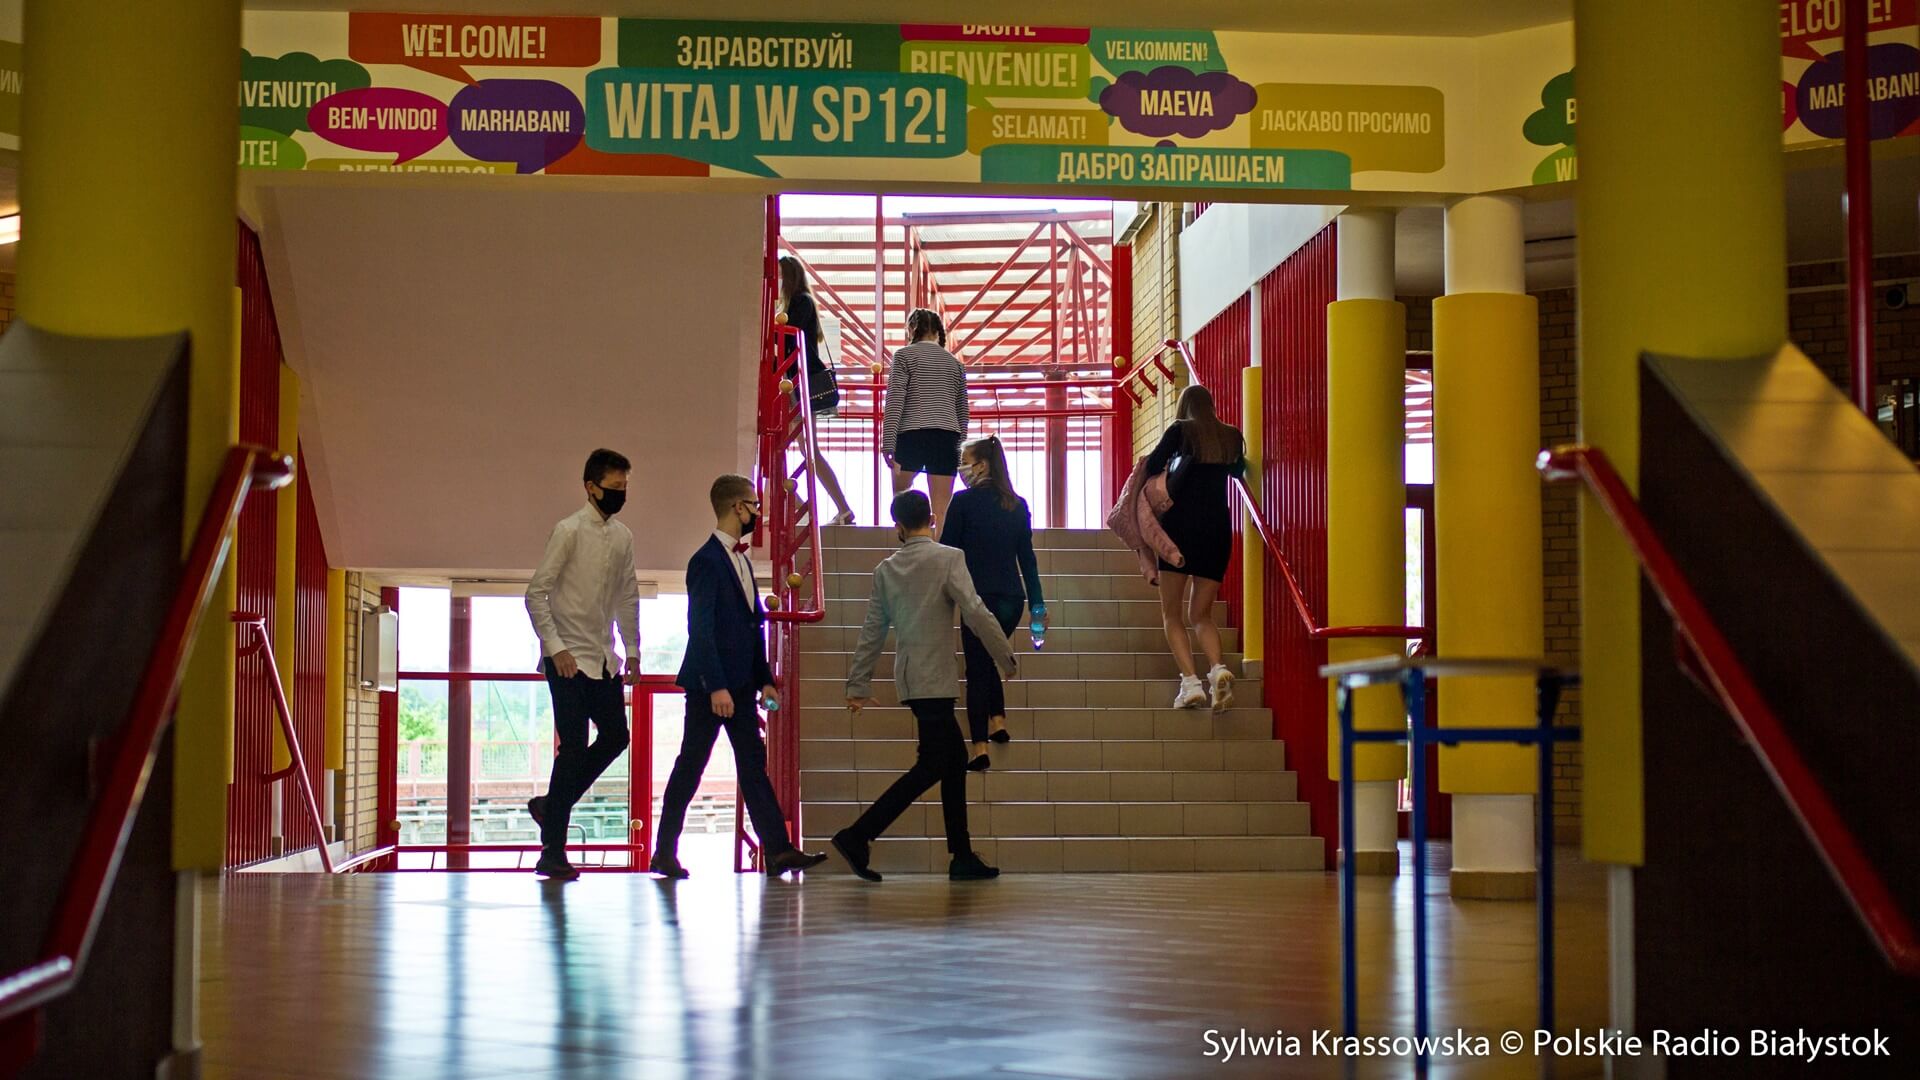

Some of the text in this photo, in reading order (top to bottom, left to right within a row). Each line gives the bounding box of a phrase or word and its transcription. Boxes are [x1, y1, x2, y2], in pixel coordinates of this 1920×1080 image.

[402, 24, 546, 59] WELCOME!
[677, 34, 853, 70] ЗДРАВСТВУЙ!
[1106, 41, 1208, 63] VELKOMMEN!
[604, 82, 742, 140] WITAJ
[756, 84, 800, 141] W
[1141, 89, 1214, 117] MAEVA
[328, 106, 437, 131] BEM-VINDO!
[461, 109, 571, 133] MARHABAN!
[992, 115, 1087, 140] SELAMAT!
[1260, 109, 1432, 135] ЛАСКАВО ПРОСИМО
[1057, 152, 1285, 184] ДАБРО ЗАПРАШАЕМ
